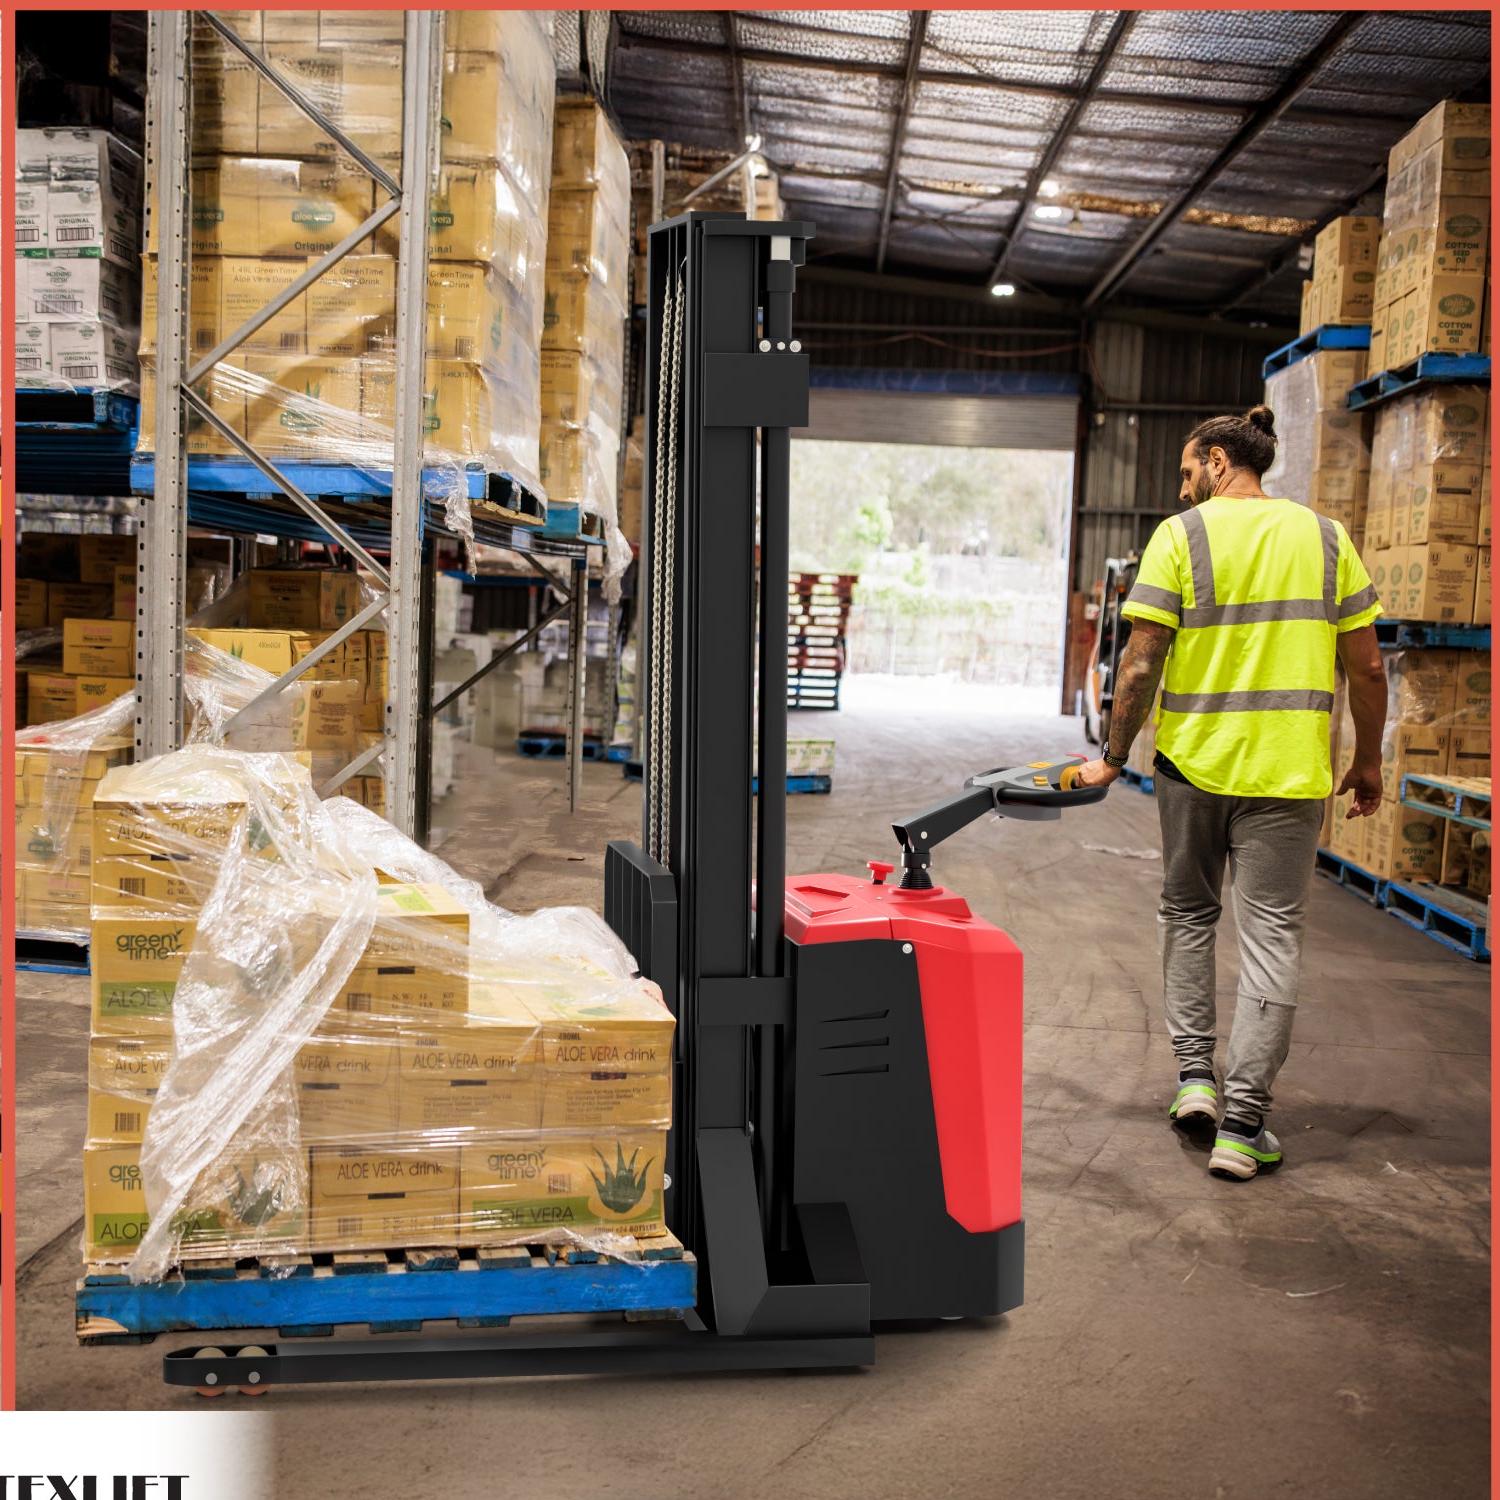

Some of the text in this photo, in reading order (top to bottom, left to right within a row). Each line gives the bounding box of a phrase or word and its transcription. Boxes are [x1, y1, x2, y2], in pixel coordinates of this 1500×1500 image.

[294, 212, 313, 221] aloe
[431, 216, 452, 224] vera
[191, 241, 223, 250] riginal
[294, 241, 334, 251] Original
[1452, 249, 1470, 257] SEED
[233, 276, 293, 284] Aloe Vera Drink
[359, 277, 381, 285] Drink
[449, 280, 470, 289] Drink
[1438, 321, 1473, 329] COTTON
[1443, 431, 1477, 439] COTTON
[117, 823, 151, 840] ALOE
[1402, 847, 1434, 855] COTTON
[116, 934, 176, 952] green
[128, 948, 169, 961] time
[107, 990, 156, 1008] ALOE
[412, 1052, 517, 1069] ALOE VERA drink
[556, 1046, 657, 1062] ALOE VERA drink
[114, 1059, 147, 1074] ALOE
[300, 1056, 372, 1073] VERA drink
[487, 1152, 540, 1171] green
[109, 1164, 140, 1182] gre
[337, 1160, 443, 1181] ALOE VERA drink
[499, 1165, 537, 1180] time
[530, 1206, 574, 1222] VERA
[100, 1222, 149, 1240] ALOE
